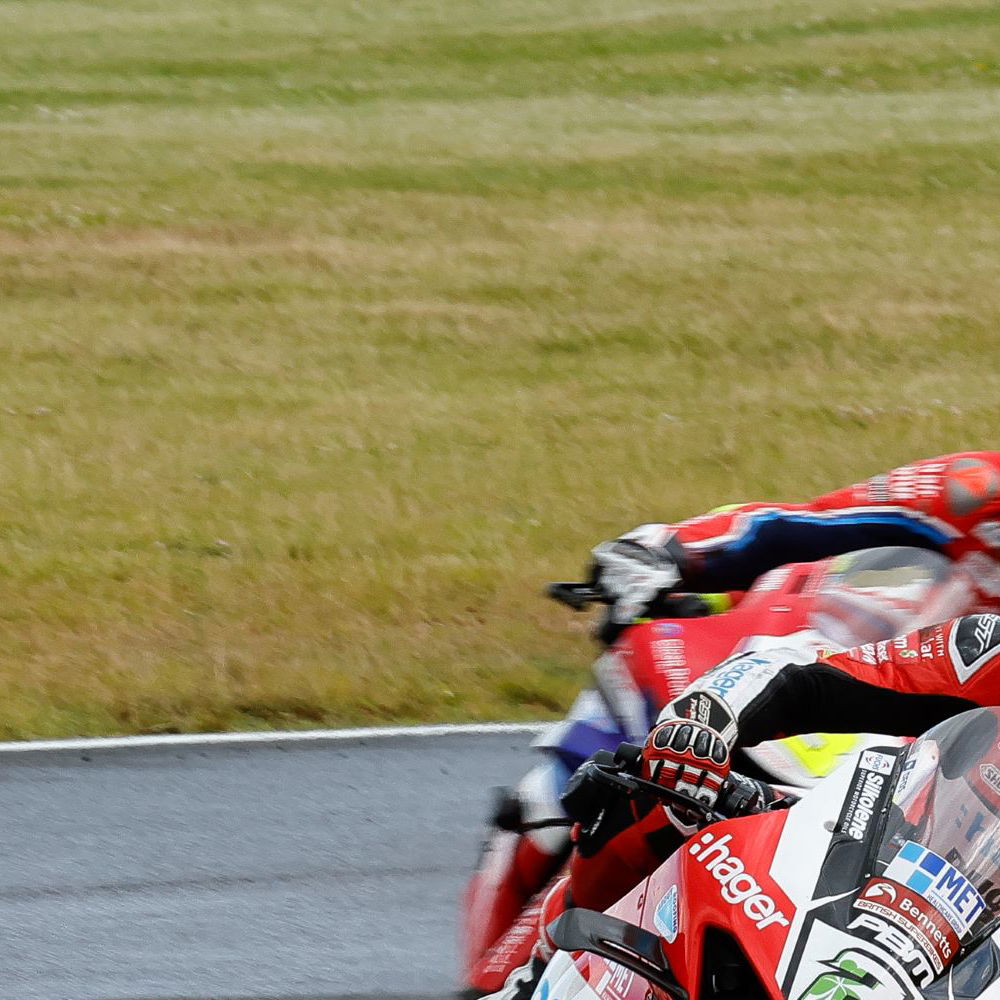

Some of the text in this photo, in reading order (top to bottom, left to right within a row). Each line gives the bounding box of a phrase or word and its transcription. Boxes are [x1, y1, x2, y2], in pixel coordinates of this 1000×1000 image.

[848, 772, 884, 840] Silkolene
[935, 866, 986, 924] MET
[857, 900, 942, 971] BRITISH SUPERBIKES
[899, 897, 952, 960] Bennetts
